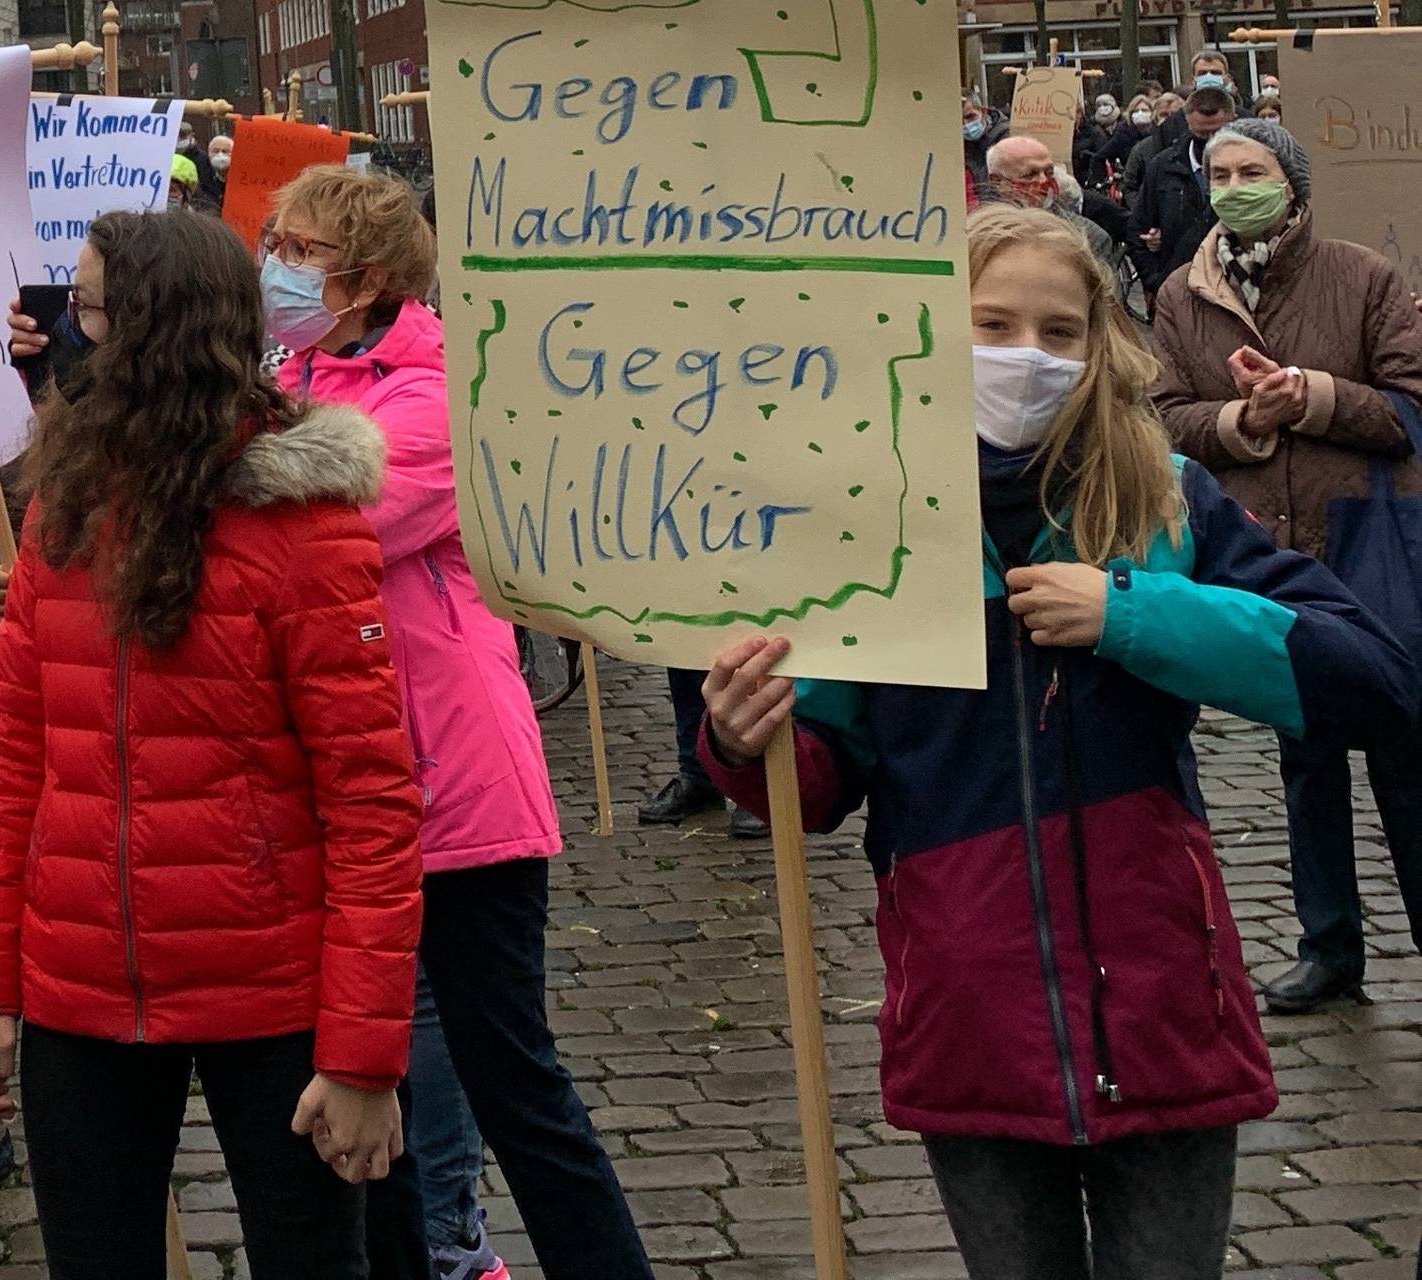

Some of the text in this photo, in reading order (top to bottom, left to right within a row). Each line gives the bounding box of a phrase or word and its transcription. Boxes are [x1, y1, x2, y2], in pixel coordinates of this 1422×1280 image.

[32, 102, 66, 142] Wir
[481, 31, 738, 145] Gegen
[28, 154, 162, 209] in Vertretung
[465, 153, 948, 250] Machtmissbrauch
[538, 302, 838, 436] Gegen
